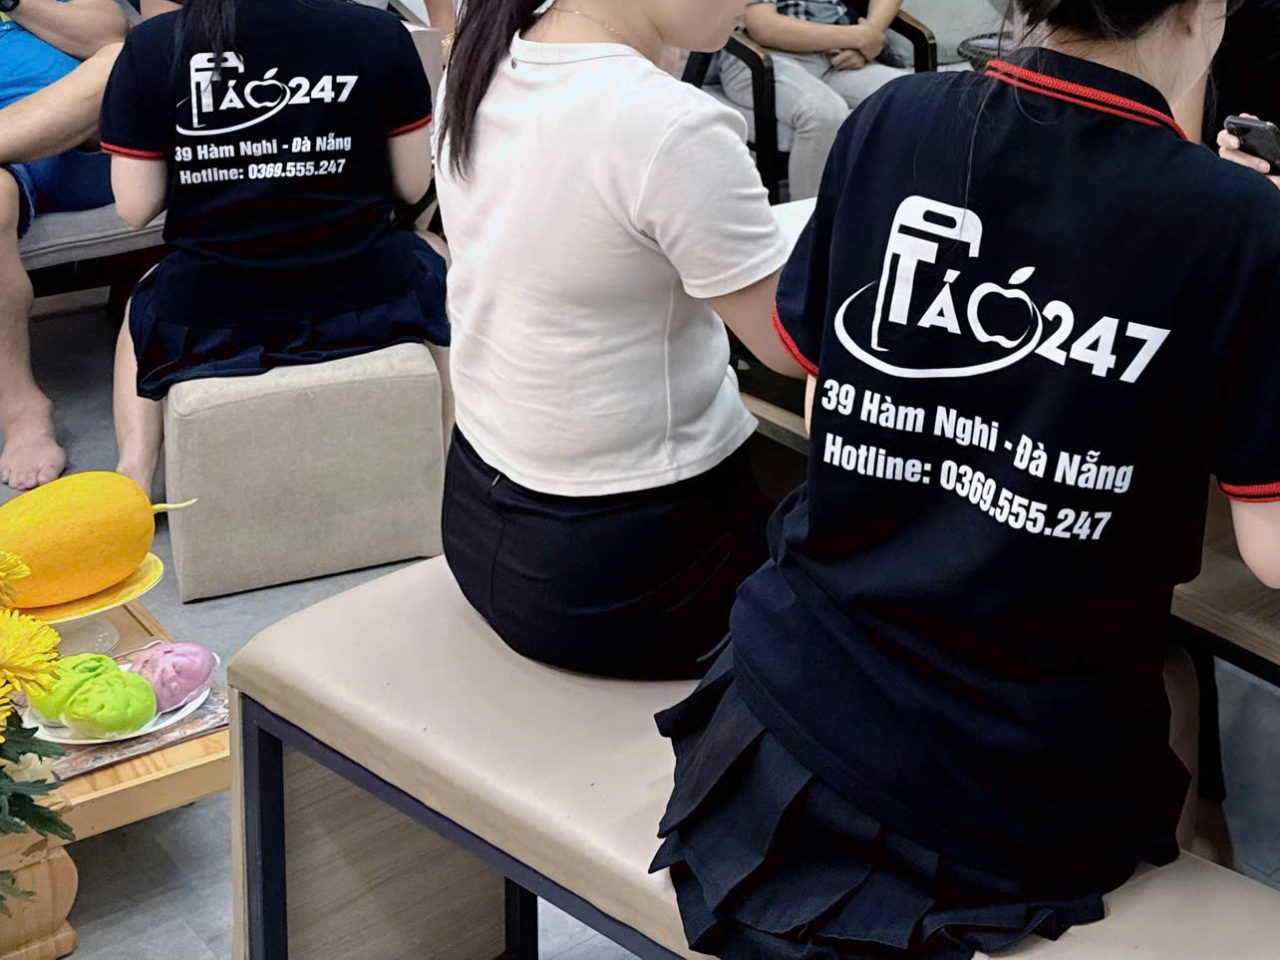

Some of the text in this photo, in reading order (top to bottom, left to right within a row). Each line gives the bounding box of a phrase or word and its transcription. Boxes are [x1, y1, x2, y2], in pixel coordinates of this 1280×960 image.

[288, 74, 359, 105] 247
[175, 145, 193, 163] 39
[197, 141, 236, 161] Hàm
[240, 138, 278, 159] Nghi
[291, 136, 311, 154] Đà
[315, 131, 352, 153] Nẵng
[179, 158, 347, 185] Hotline: 0369.555.247
[1034, 299, 1172, 384] 247
[821, 378, 856, 416] 39
[860, 388, 926, 434] Hàm
[933, 405, 1000, 452] Nghi
[1012, 433, 1047, 478] Đà
[1054, 449, 1134, 494] Nẵng
[823, 432, 1113, 541] Hotline: 0369.555.247
